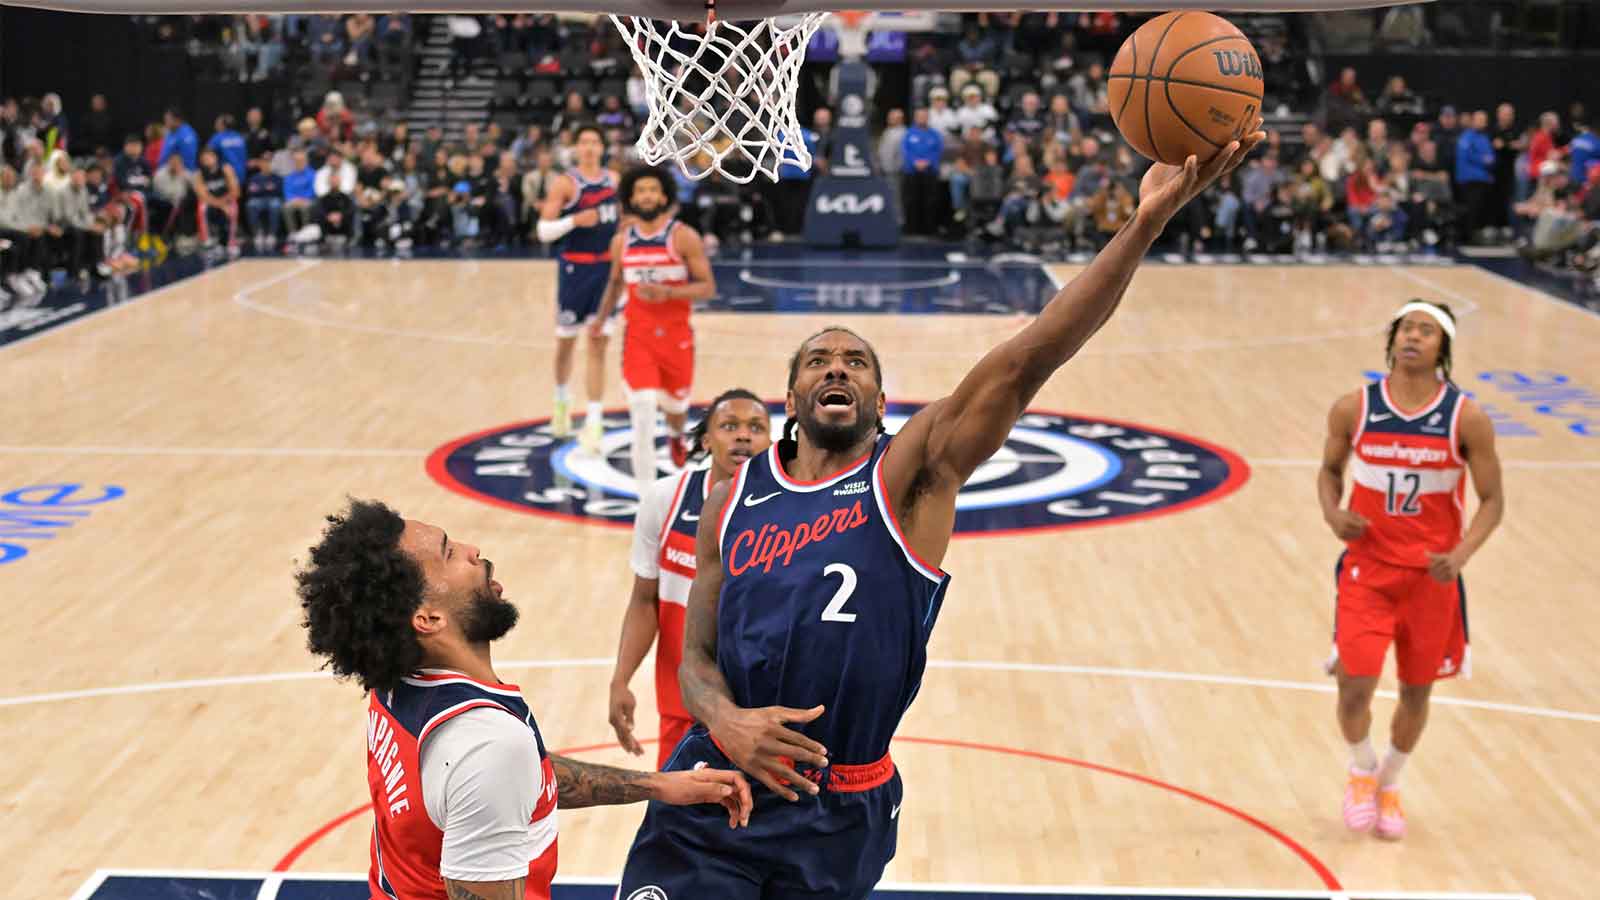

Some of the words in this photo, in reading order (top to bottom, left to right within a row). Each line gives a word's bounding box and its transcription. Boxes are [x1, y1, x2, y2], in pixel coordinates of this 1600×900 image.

[844, 481, 866, 490] VISIT
[1386, 472, 1421, 516] 12
[729, 500, 868, 576] Clippers
[821, 562, 857, 622] 2
